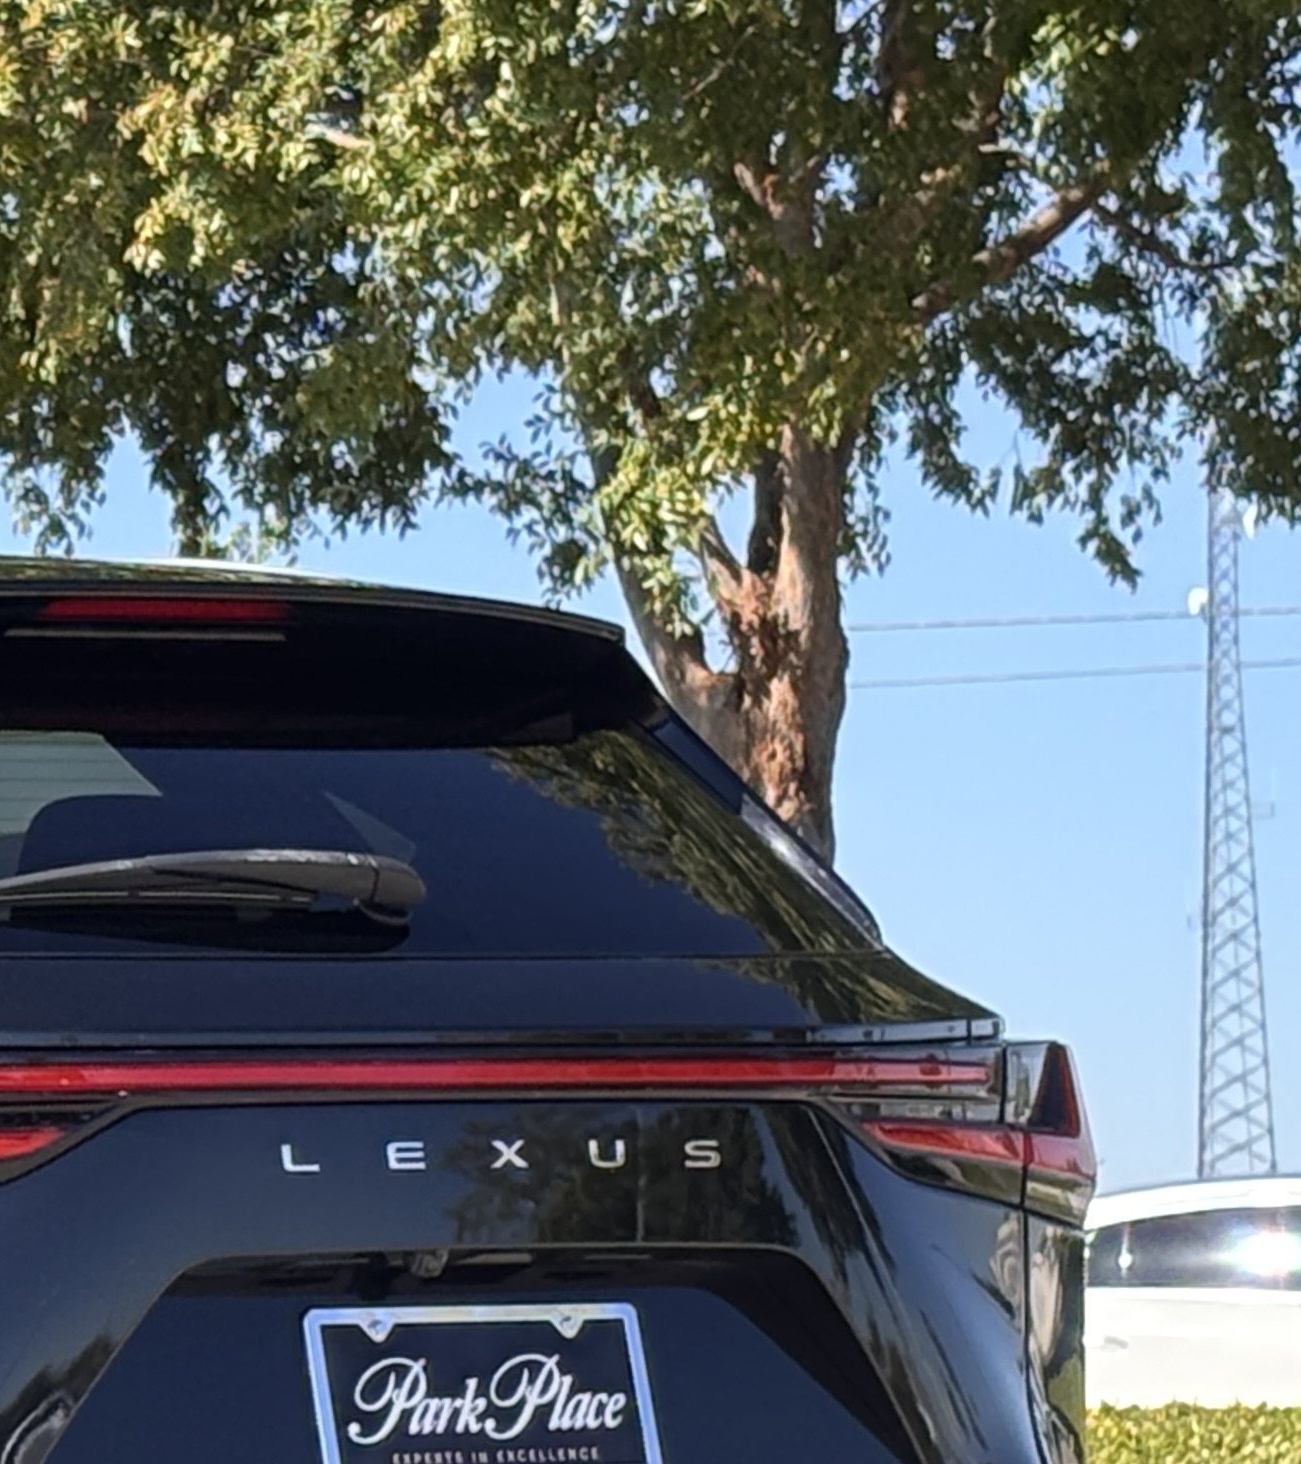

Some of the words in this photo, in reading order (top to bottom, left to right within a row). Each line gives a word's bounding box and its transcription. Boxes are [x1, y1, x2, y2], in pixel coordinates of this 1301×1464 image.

[279, 1138, 722, 1173] LEXUS
[347, 1356, 488, 1445] Park
[484, 1353, 627, 1441] Place
[470, 1450, 489, 1464] IN
[496, 1446, 600, 1464] EXCELLENCE
